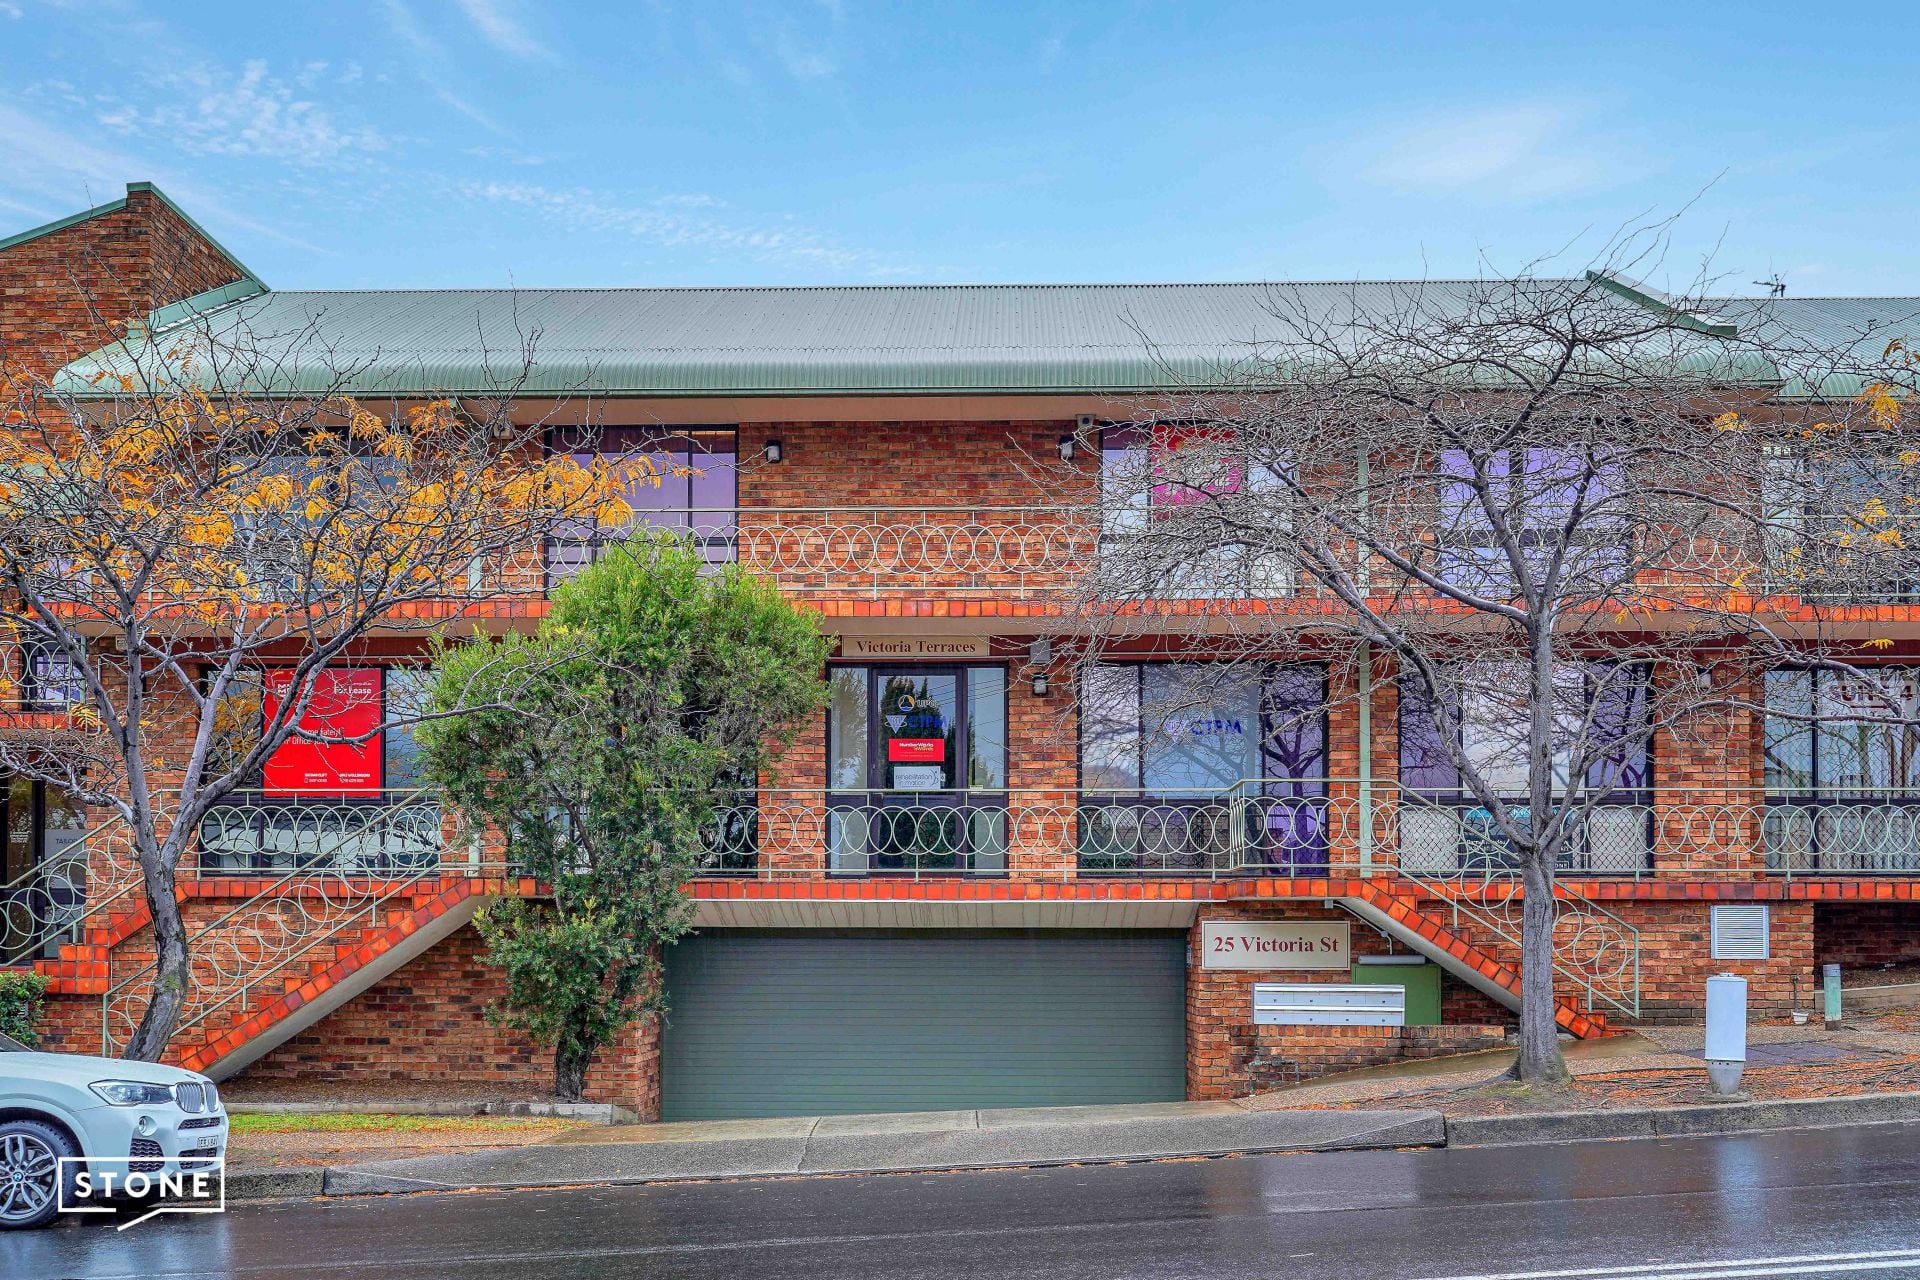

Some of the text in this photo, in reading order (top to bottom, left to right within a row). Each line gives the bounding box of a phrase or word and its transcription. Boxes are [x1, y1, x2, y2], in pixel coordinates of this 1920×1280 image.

[856, 640, 976, 653] Victoria Terraces
[349, 686, 372, 695] Lease
[908, 715, 948, 729] CTPM
[1213, 936, 1339, 953] 25 Victoria St
